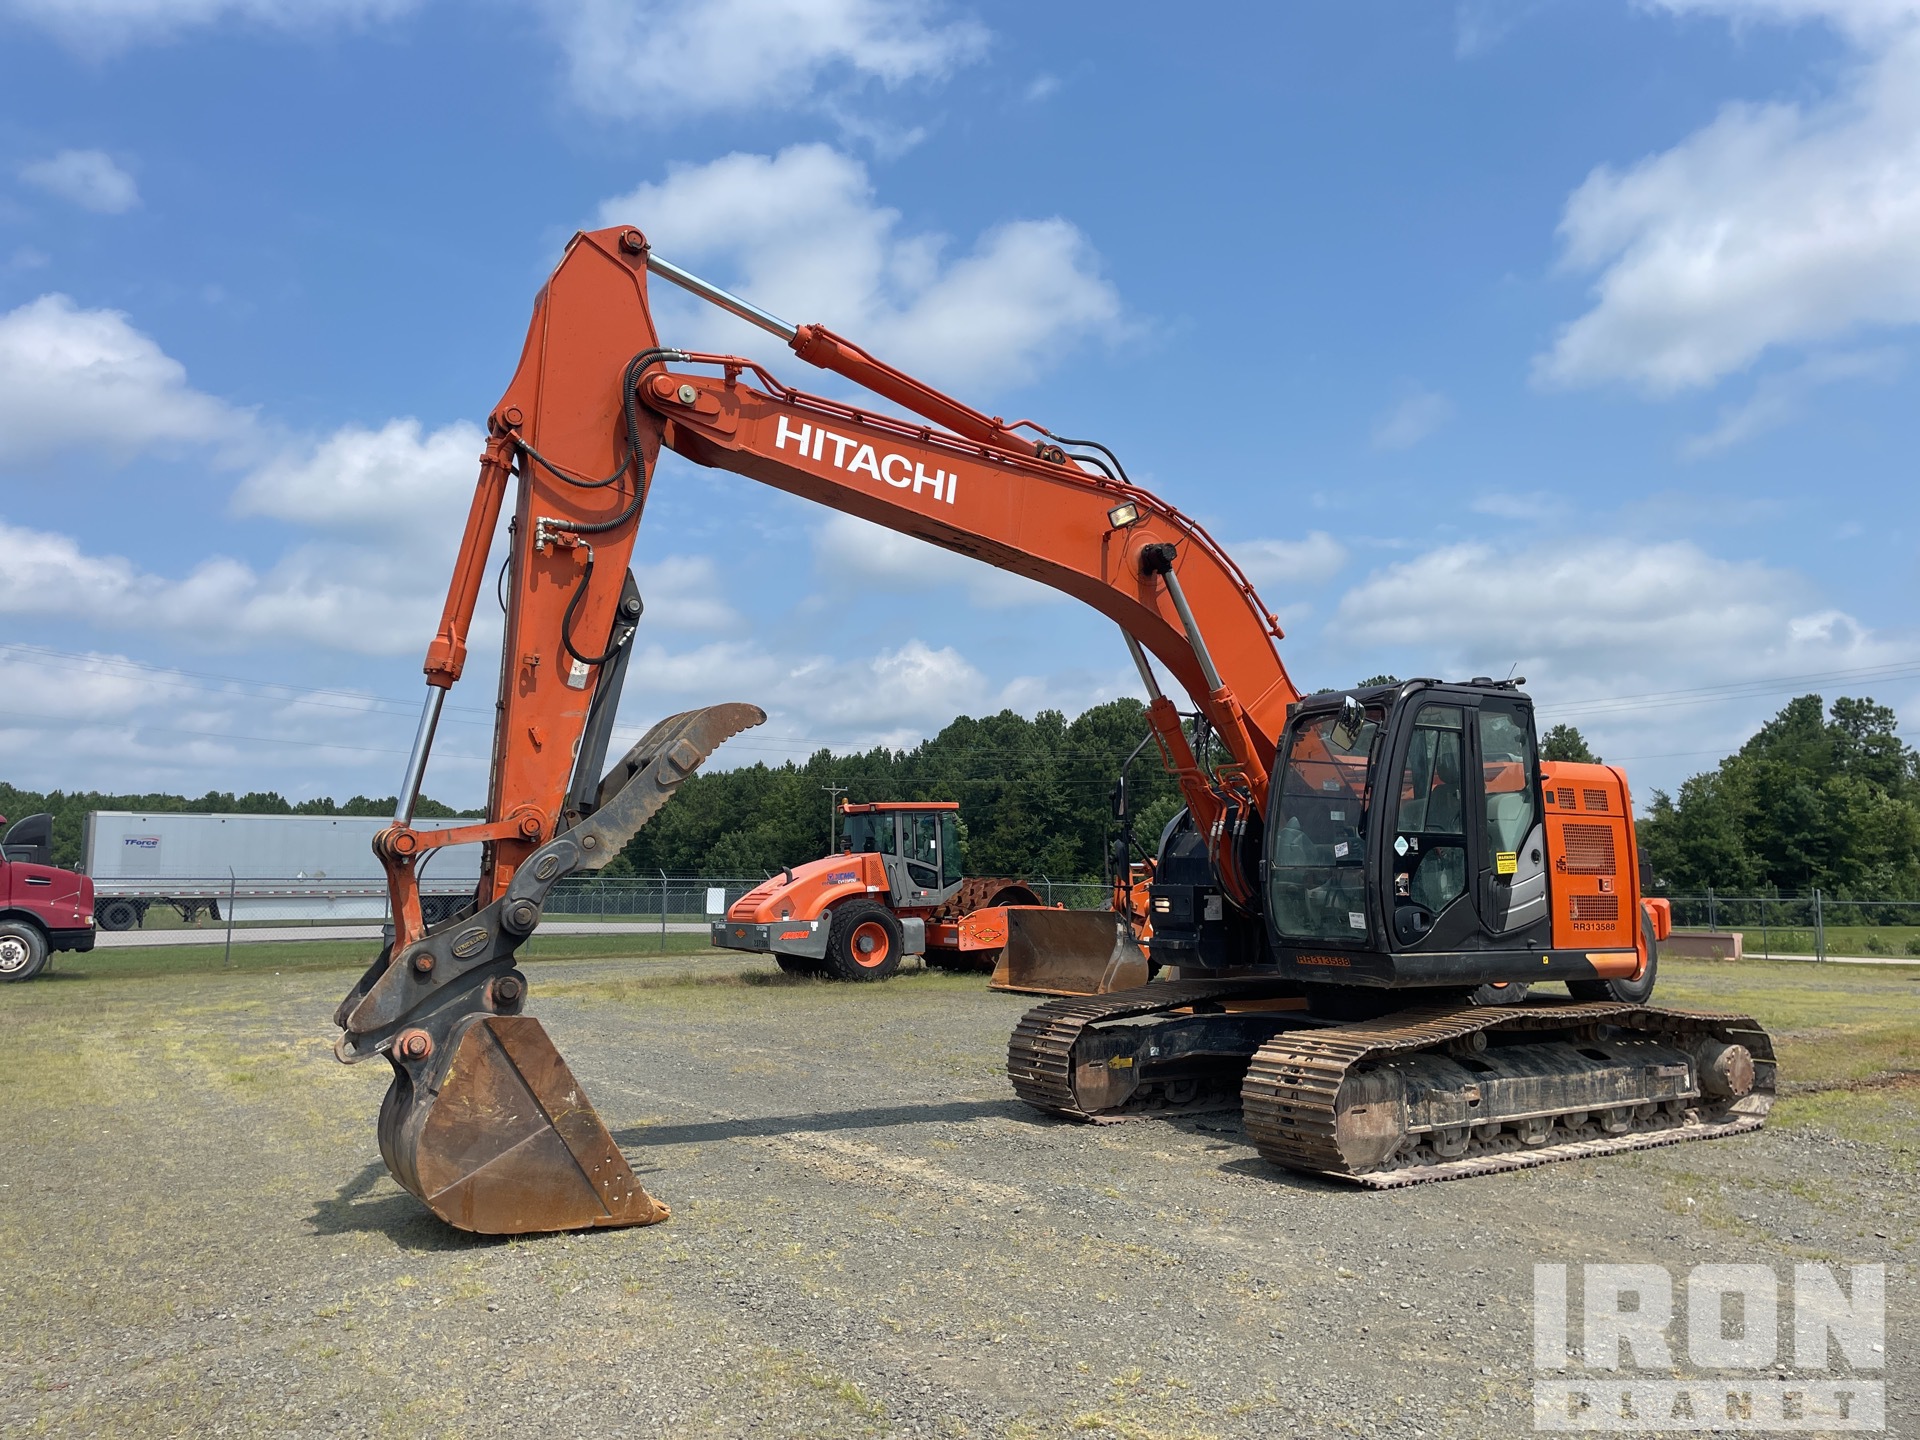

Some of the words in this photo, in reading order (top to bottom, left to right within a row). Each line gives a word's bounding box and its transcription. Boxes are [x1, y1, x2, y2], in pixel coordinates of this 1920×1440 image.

[776, 415, 957, 505] HITACHI
[1573, 923, 1616, 931] RR313588
[1296, 955, 1351, 966] RR313588
